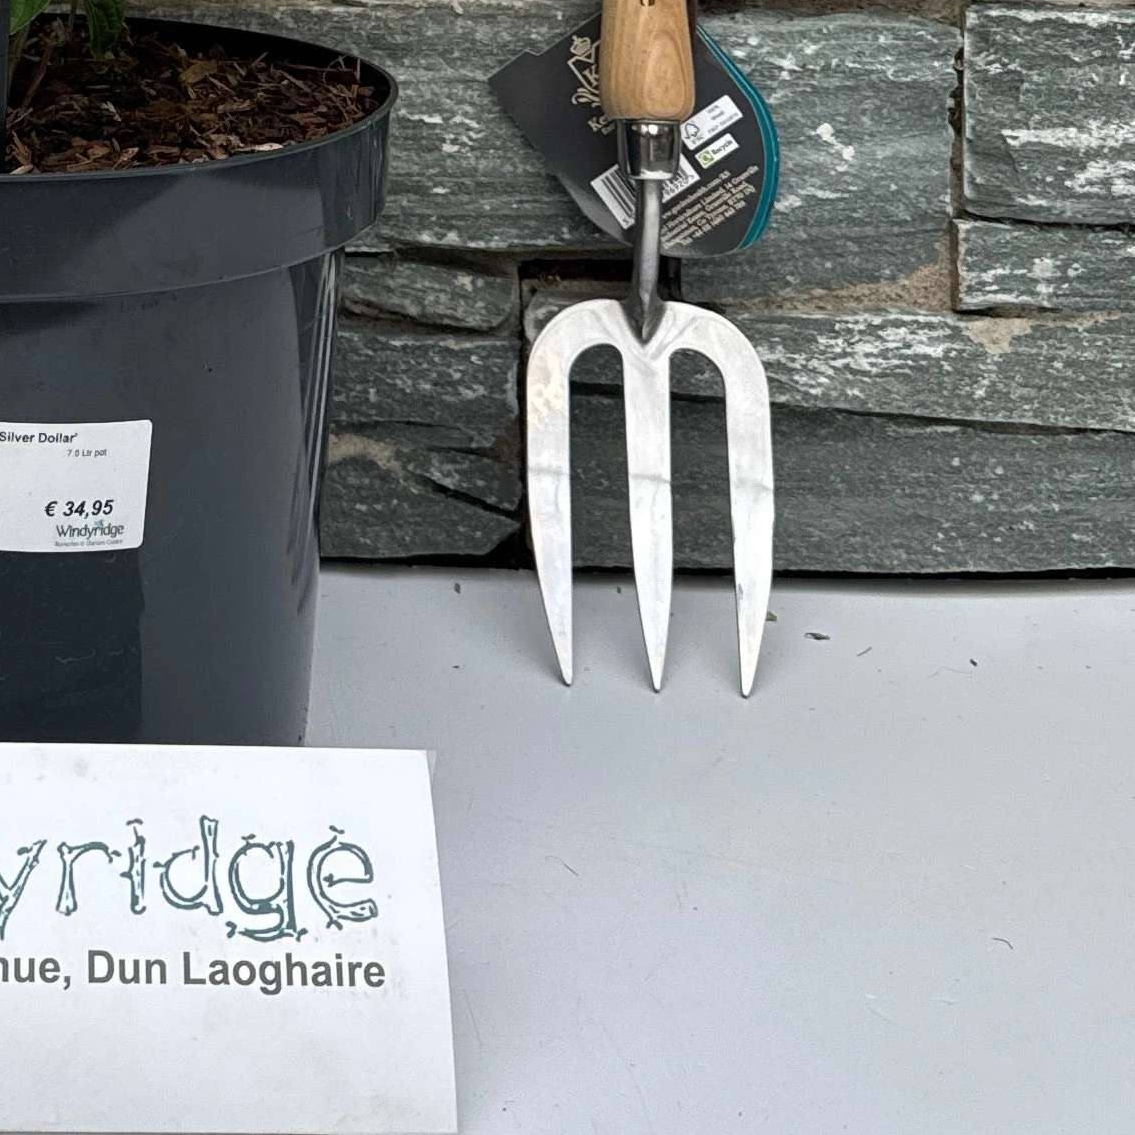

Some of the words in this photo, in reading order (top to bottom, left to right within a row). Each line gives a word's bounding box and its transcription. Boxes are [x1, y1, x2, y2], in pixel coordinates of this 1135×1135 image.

[38, 432, 78, 443] Dollar'
[94, 448, 107, 458] pot
[44, 500, 58, 517] €
[63, 499, 114, 519] 34,95
[56, 522, 124, 540] Windyridge
[87, 950, 167, 985] Dun
[182, 951, 386, 996] Laoghaire
